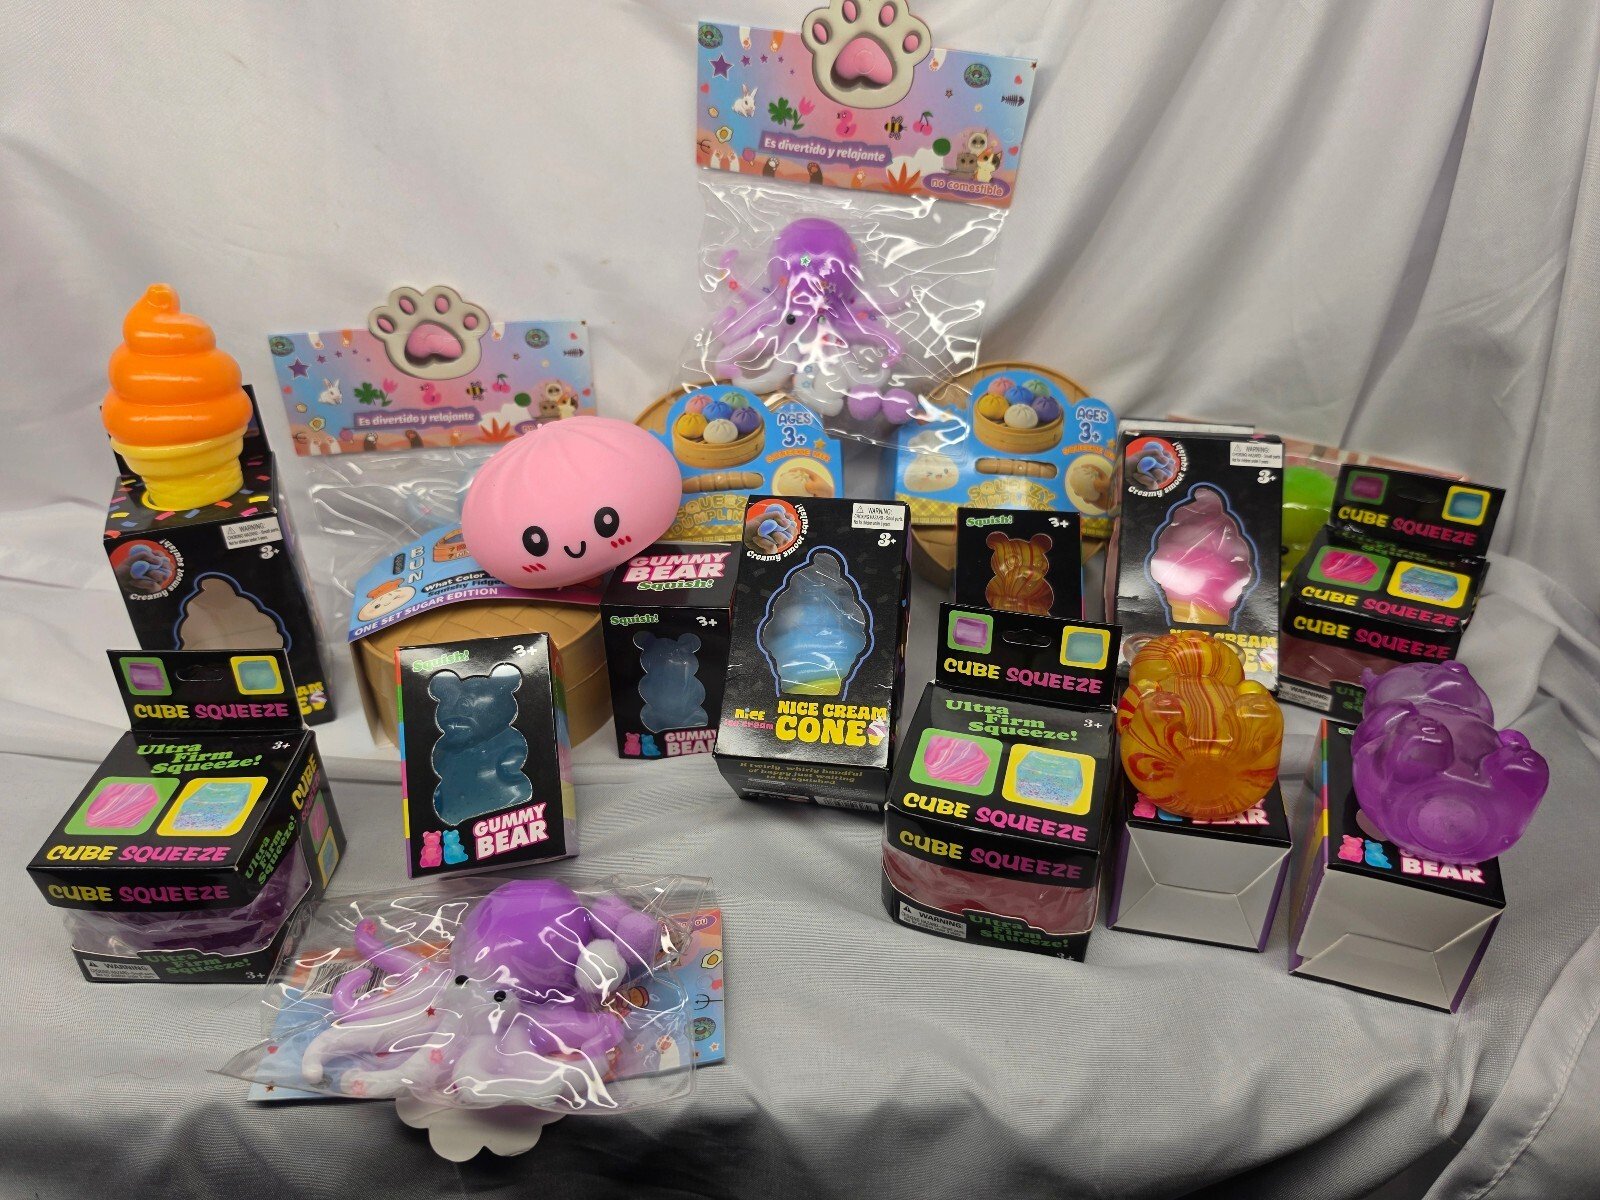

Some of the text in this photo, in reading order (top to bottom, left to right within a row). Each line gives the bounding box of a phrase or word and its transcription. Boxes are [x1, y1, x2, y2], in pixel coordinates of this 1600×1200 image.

[764, 137, 886, 163] Es divertido y relajante
[930, 178, 1004, 198] no comestible
[358, 412, 475, 427] Es divertido y relajante
[777, 412, 813, 427] AGES
[1076, 405, 1109, 424] AGES
[781, 425, 807, 448] 3+
[1079, 420, 1101, 443] 3+
[1257, 470, 1277, 484] 3+
[1128, 486, 1163, 498] Creamy
[677, 494, 748, 518] SQUEEZ
[671, 507, 745, 536] DUMPLIN
[965, 514, 1013, 528] Squish!
[1048, 517, 1069, 528] 3+
[1338, 506, 1478, 547] CUBE SQUEEZE
[746, 550, 782, 562] Creamy
[783, 535, 805, 557] smoot
[877, 532, 897, 547] 3+
[261, 544, 280, 560] 3+
[630, 552, 732, 567] GUMMY
[425, 572, 485, 592] What Color
[622, 563, 726, 582] BEAR
[636, 579, 715, 592] Squish!
[129, 590, 169, 601] Creamy
[354, 588, 498, 636] ONE SET SUGAR EDITION
[1301, 586, 1460, 628] CUBE SQUEEZE
[610, 614, 660, 626] Squish!
[696, 616, 718, 627] 3+
[1293, 615, 1451, 660] CUBE SQUEEZE
[512, 644, 538, 657] 3+
[412, 650, 470, 672] Squish!
[943, 657, 1104, 694] CUBE SQUEEZE
[133, 703, 191, 719] CUBE
[194, 703, 290, 720] SQUEEZE
[777, 700, 888, 721] NICE CREAM
[945, 699, 1010, 715] Ultra
[985, 714, 1046, 729] Firm
[1083, 719, 1103, 729] 3+
[968, 721, 1079, 742] Squeeze!
[137, 743, 202, 757] Ultra
[272, 740, 291, 750] 3+
[151, 755, 263, 775] Squeeze!
[171, 751, 232, 763] Firm
[291, 752, 318, 811] CUBE
[473, 804, 548, 836] GUMMY
[903, 792, 1088, 842] CUBE SQUEEZE
[476, 820, 549, 860] BEAR
[46, 845, 231, 862] CUBE SQUEEZE
[245, 836, 271, 879] Ultra
[258, 815, 296, 885] Squeeze!
[900, 830, 1082, 880] CUBE SQUEEZE
[1402, 856, 1486, 884] BEAR
[48, 884, 230, 903] CUBE SQUEEZE
[918, 912, 964, 929] WARNING:
[968, 914, 1023, 930] Ultra
[980, 929, 1069, 948] Squeeze!
[992, 925, 1042, 940] Firm
[144, 954, 198, 963] Ultra
[165, 958, 252, 975] Squeeze!
[245, 971, 266, 979] 3+
